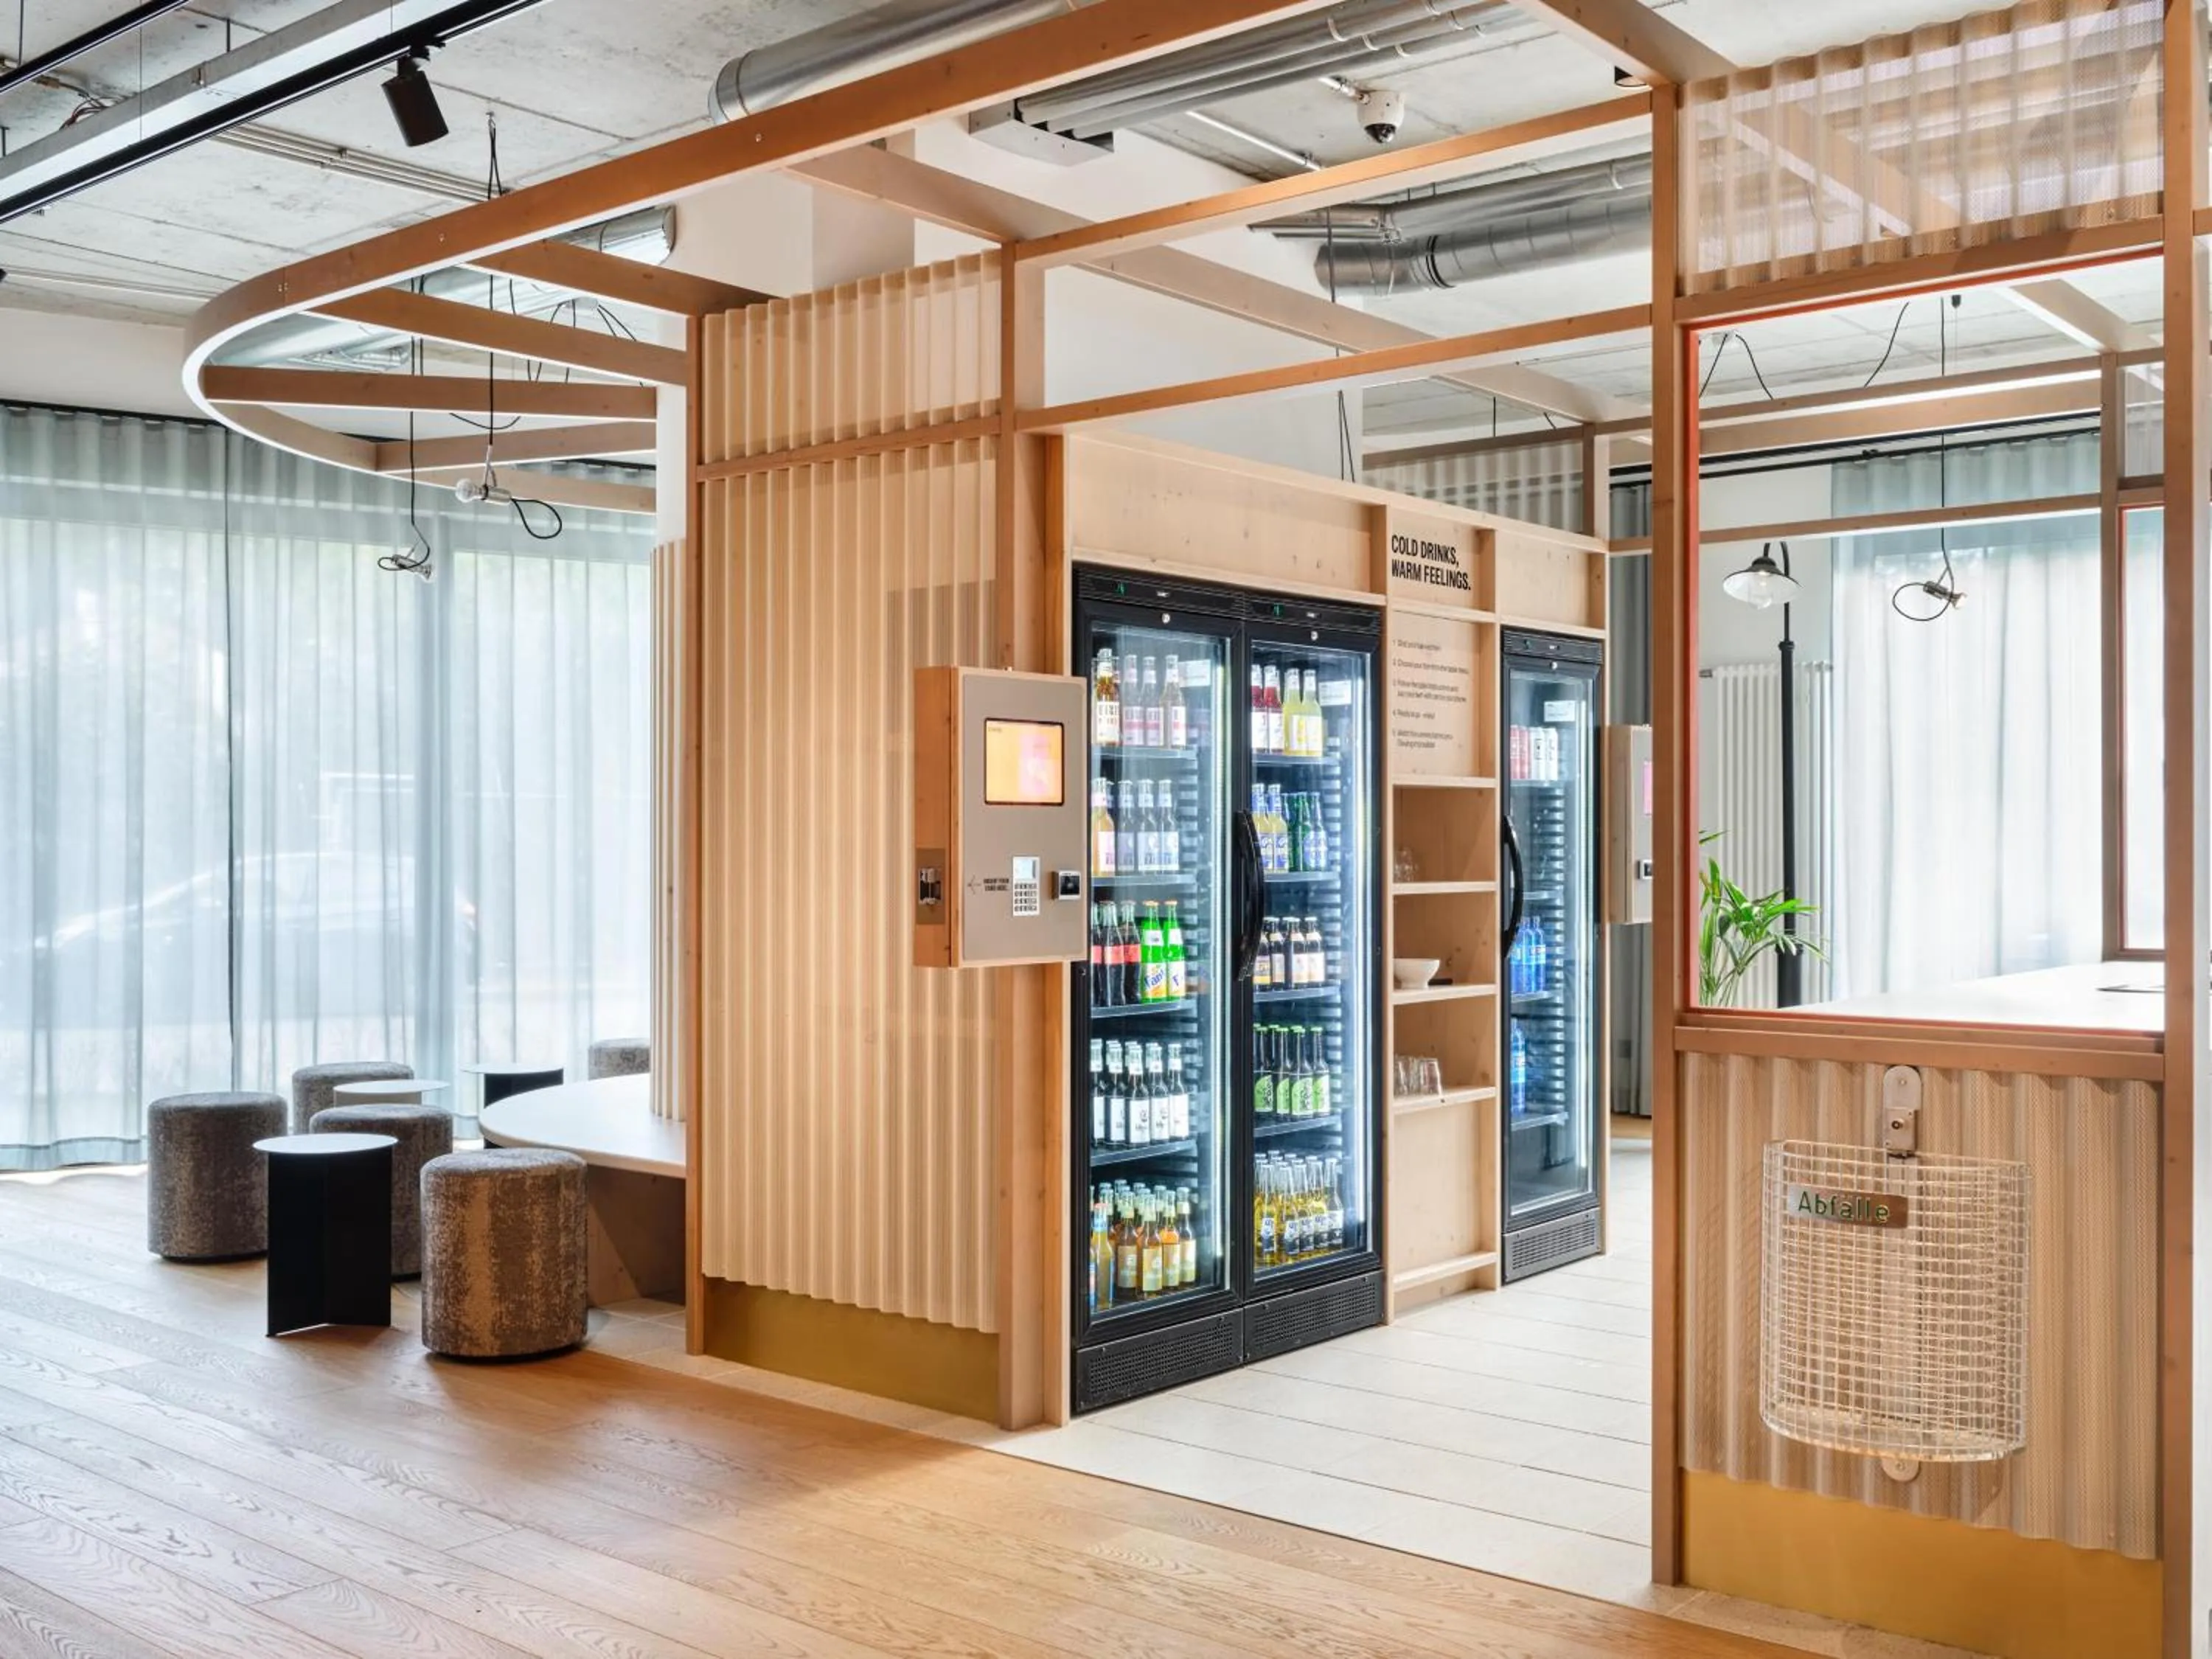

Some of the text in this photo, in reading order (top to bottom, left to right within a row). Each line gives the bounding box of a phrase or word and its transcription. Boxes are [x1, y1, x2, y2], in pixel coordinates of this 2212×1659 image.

[1391, 535, 1459, 568] COLD DRINKS,
[1391, 559, 1472, 591] WARM FEELINGS.
